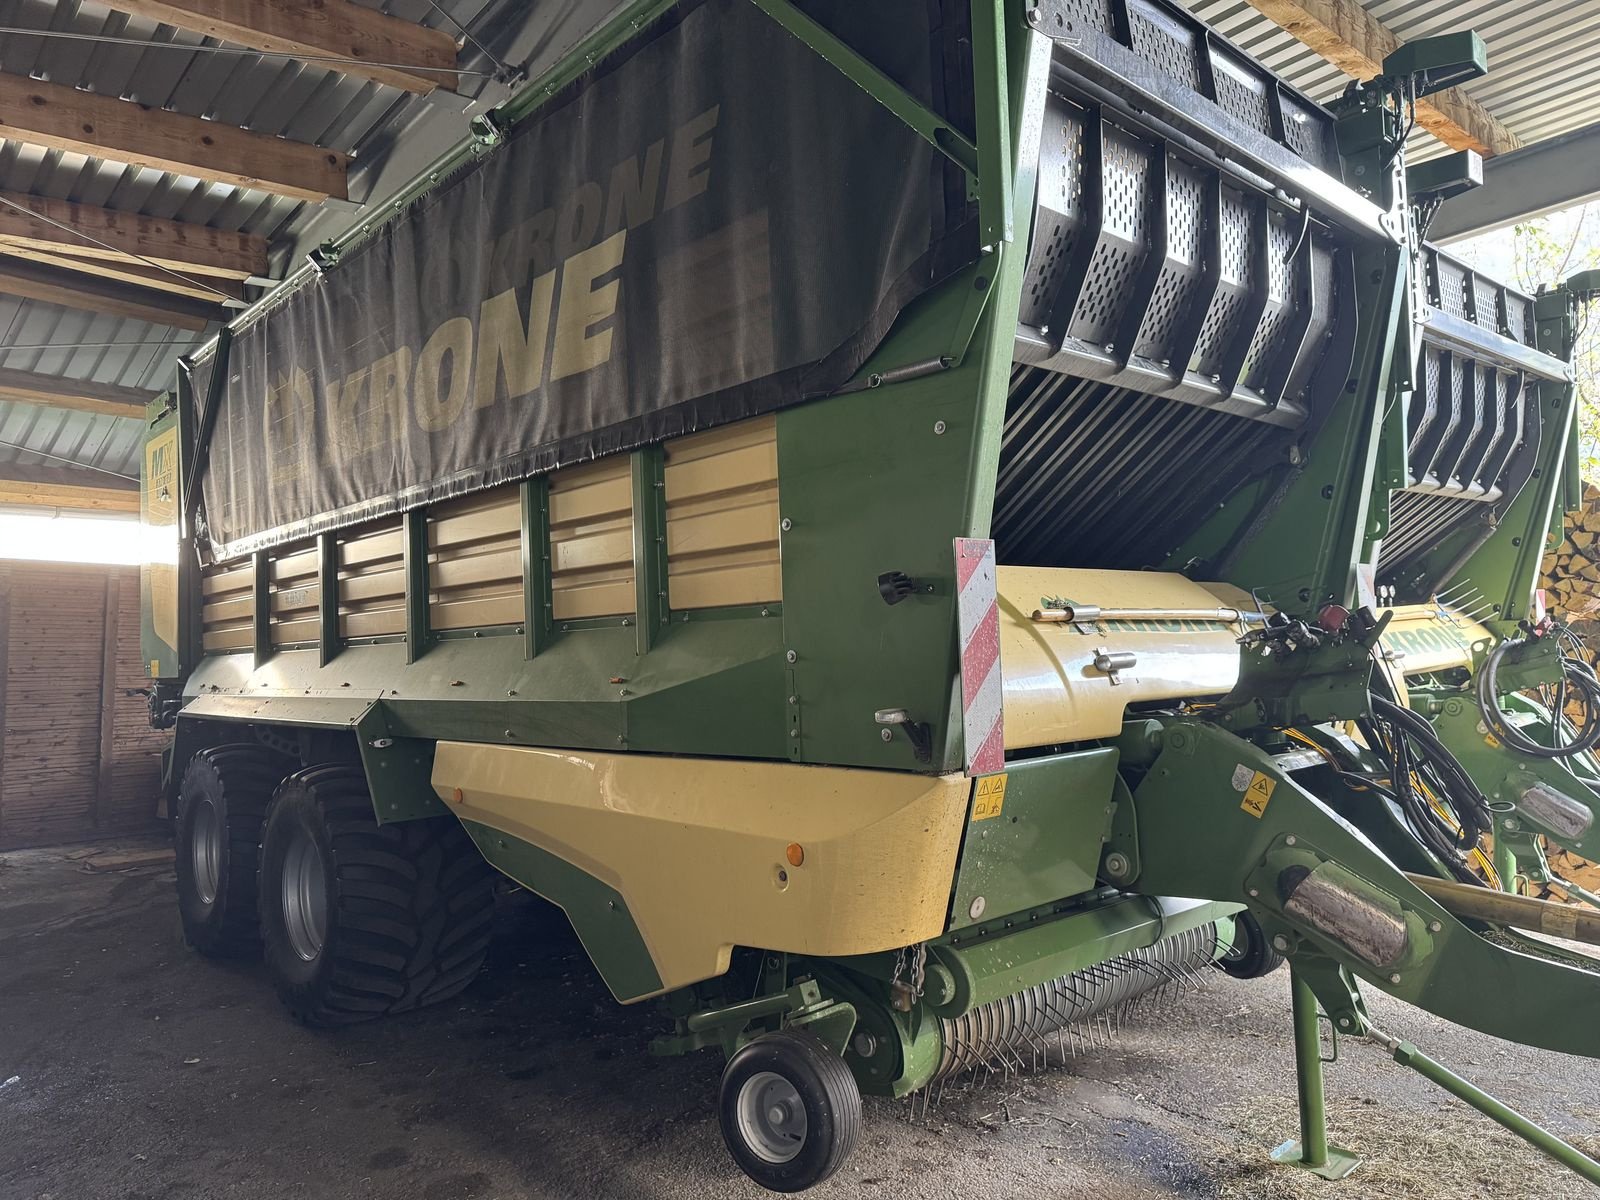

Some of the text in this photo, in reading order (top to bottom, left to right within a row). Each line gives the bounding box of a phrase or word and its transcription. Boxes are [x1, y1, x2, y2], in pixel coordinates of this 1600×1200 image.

[490, 104, 719, 295] KRONE
[321, 229, 627, 467] KRONE
[1382, 625, 1470, 655] KRONE
